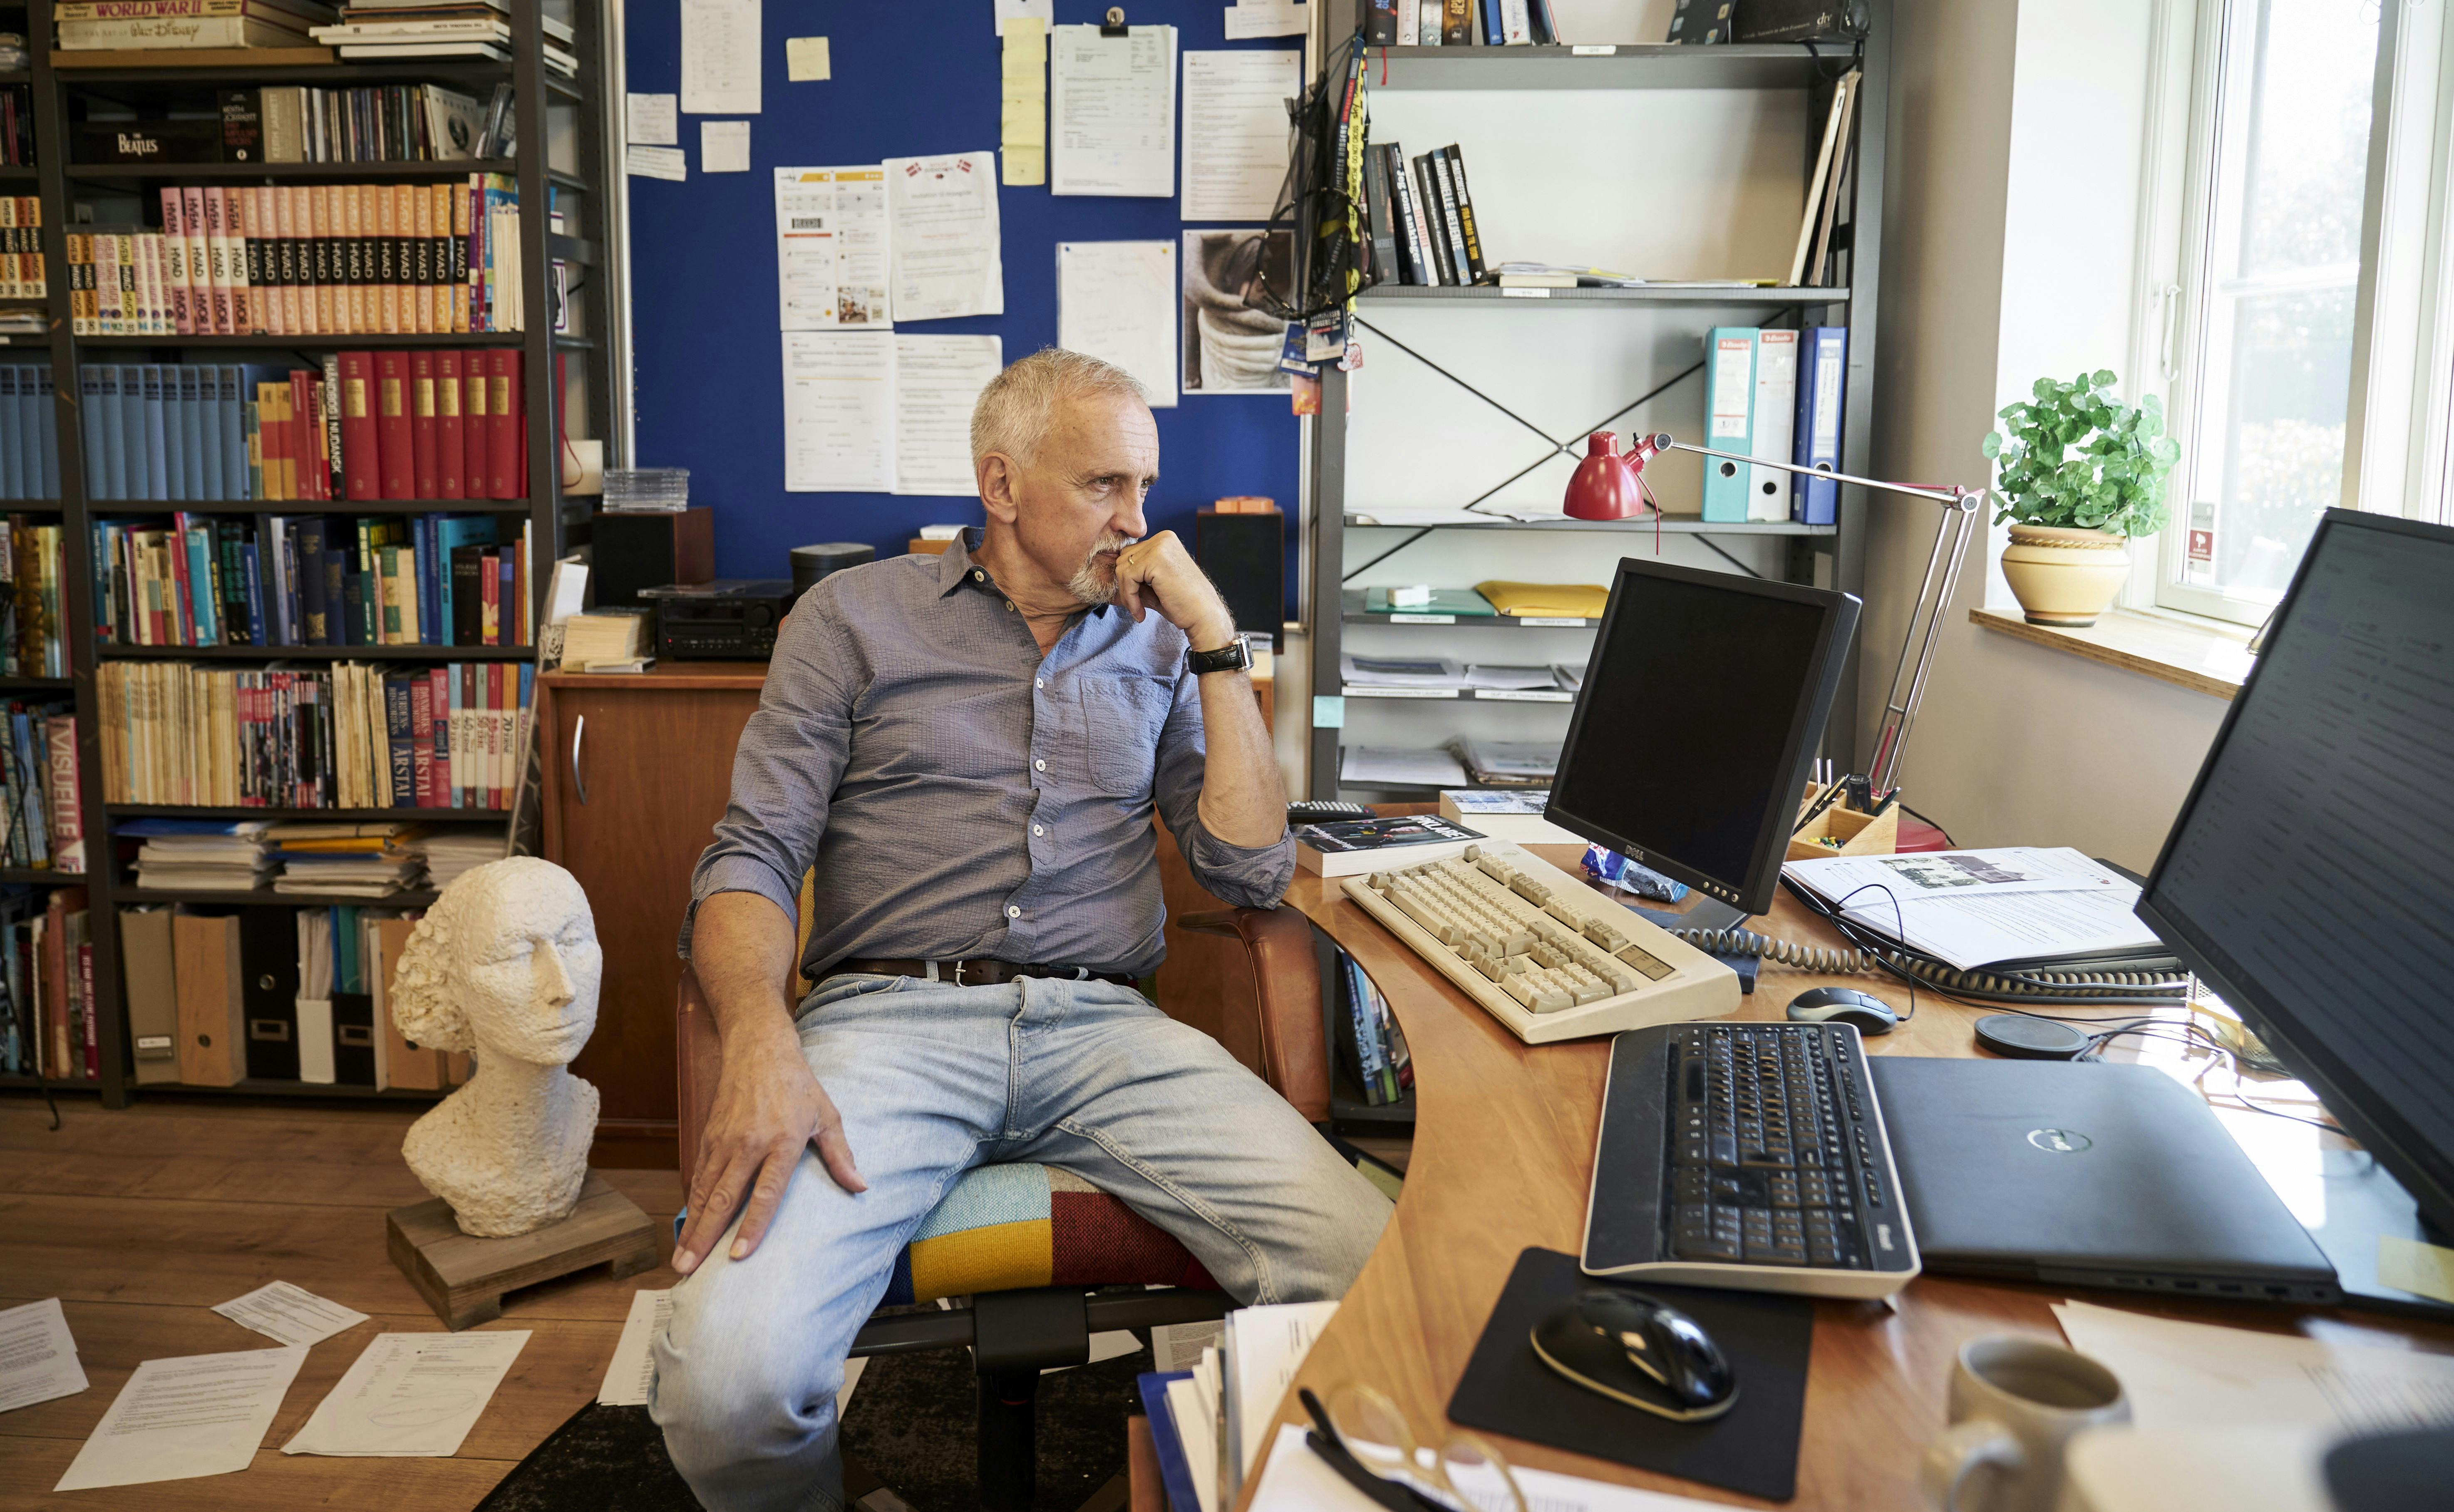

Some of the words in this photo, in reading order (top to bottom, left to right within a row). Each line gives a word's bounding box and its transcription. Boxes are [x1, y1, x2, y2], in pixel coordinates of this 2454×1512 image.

[96, 1, 151, 17] WORLD
[155, 0, 188, 15] WAR
[1350, 103, 1360, 119] sky
[118, 133, 158, 156] BEATLES
[1397, 170, 1406, 190] Jeg
[1400, 190, 1412, 213] som
[1434, 158, 1456, 210] KRIMINELLE
[1446, 211, 1464, 251] BETJENTE
[1405, 214, 1421, 265] anklager
[170, 247, 183, 278] HVAD
[193, 247, 203, 277] HVAD
[212, 248, 223, 278] HVAD
[231, 247, 243, 278] HVAD
[248, 244, 259, 280] HVAD
[263, 244, 275, 280] HVAD
[280, 243, 291, 280] HVAD
[298, 243, 310, 280] HVAD
[316, 242, 327, 279] HVAD
[332, 242, 342, 279] HVAD
[349, 242, 360, 279] HVAD
[364, 242, 373, 278] HVAD
[382, 242, 391, 278] HVAD
[400, 241, 410, 279] HVAD
[417, 242, 427, 280] HVAD
[437, 242, 447, 279] HVAD
[457, 240, 466, 278] HVAD
[175, 291, 186, 320] HVOR
[197, 294, 208, 324] HVOR
[217, 294, 228, 324] HVOR
[236, 294, 246, 324] HVOR
[328, 421, 342, 474] NUDANSK
[2192, 513, 2213, 522] verisure
[503, 716, 513, 731] 70
[50, 729, 78, 836] VISUELLE
[393, 746, 412, 800] ÅRSTAL
[414, 746, 432, 798] ÅRSTAL
[1406, 814, 1473, 840] OPKLARET
[1625, 845, 1644, 861] DELL
